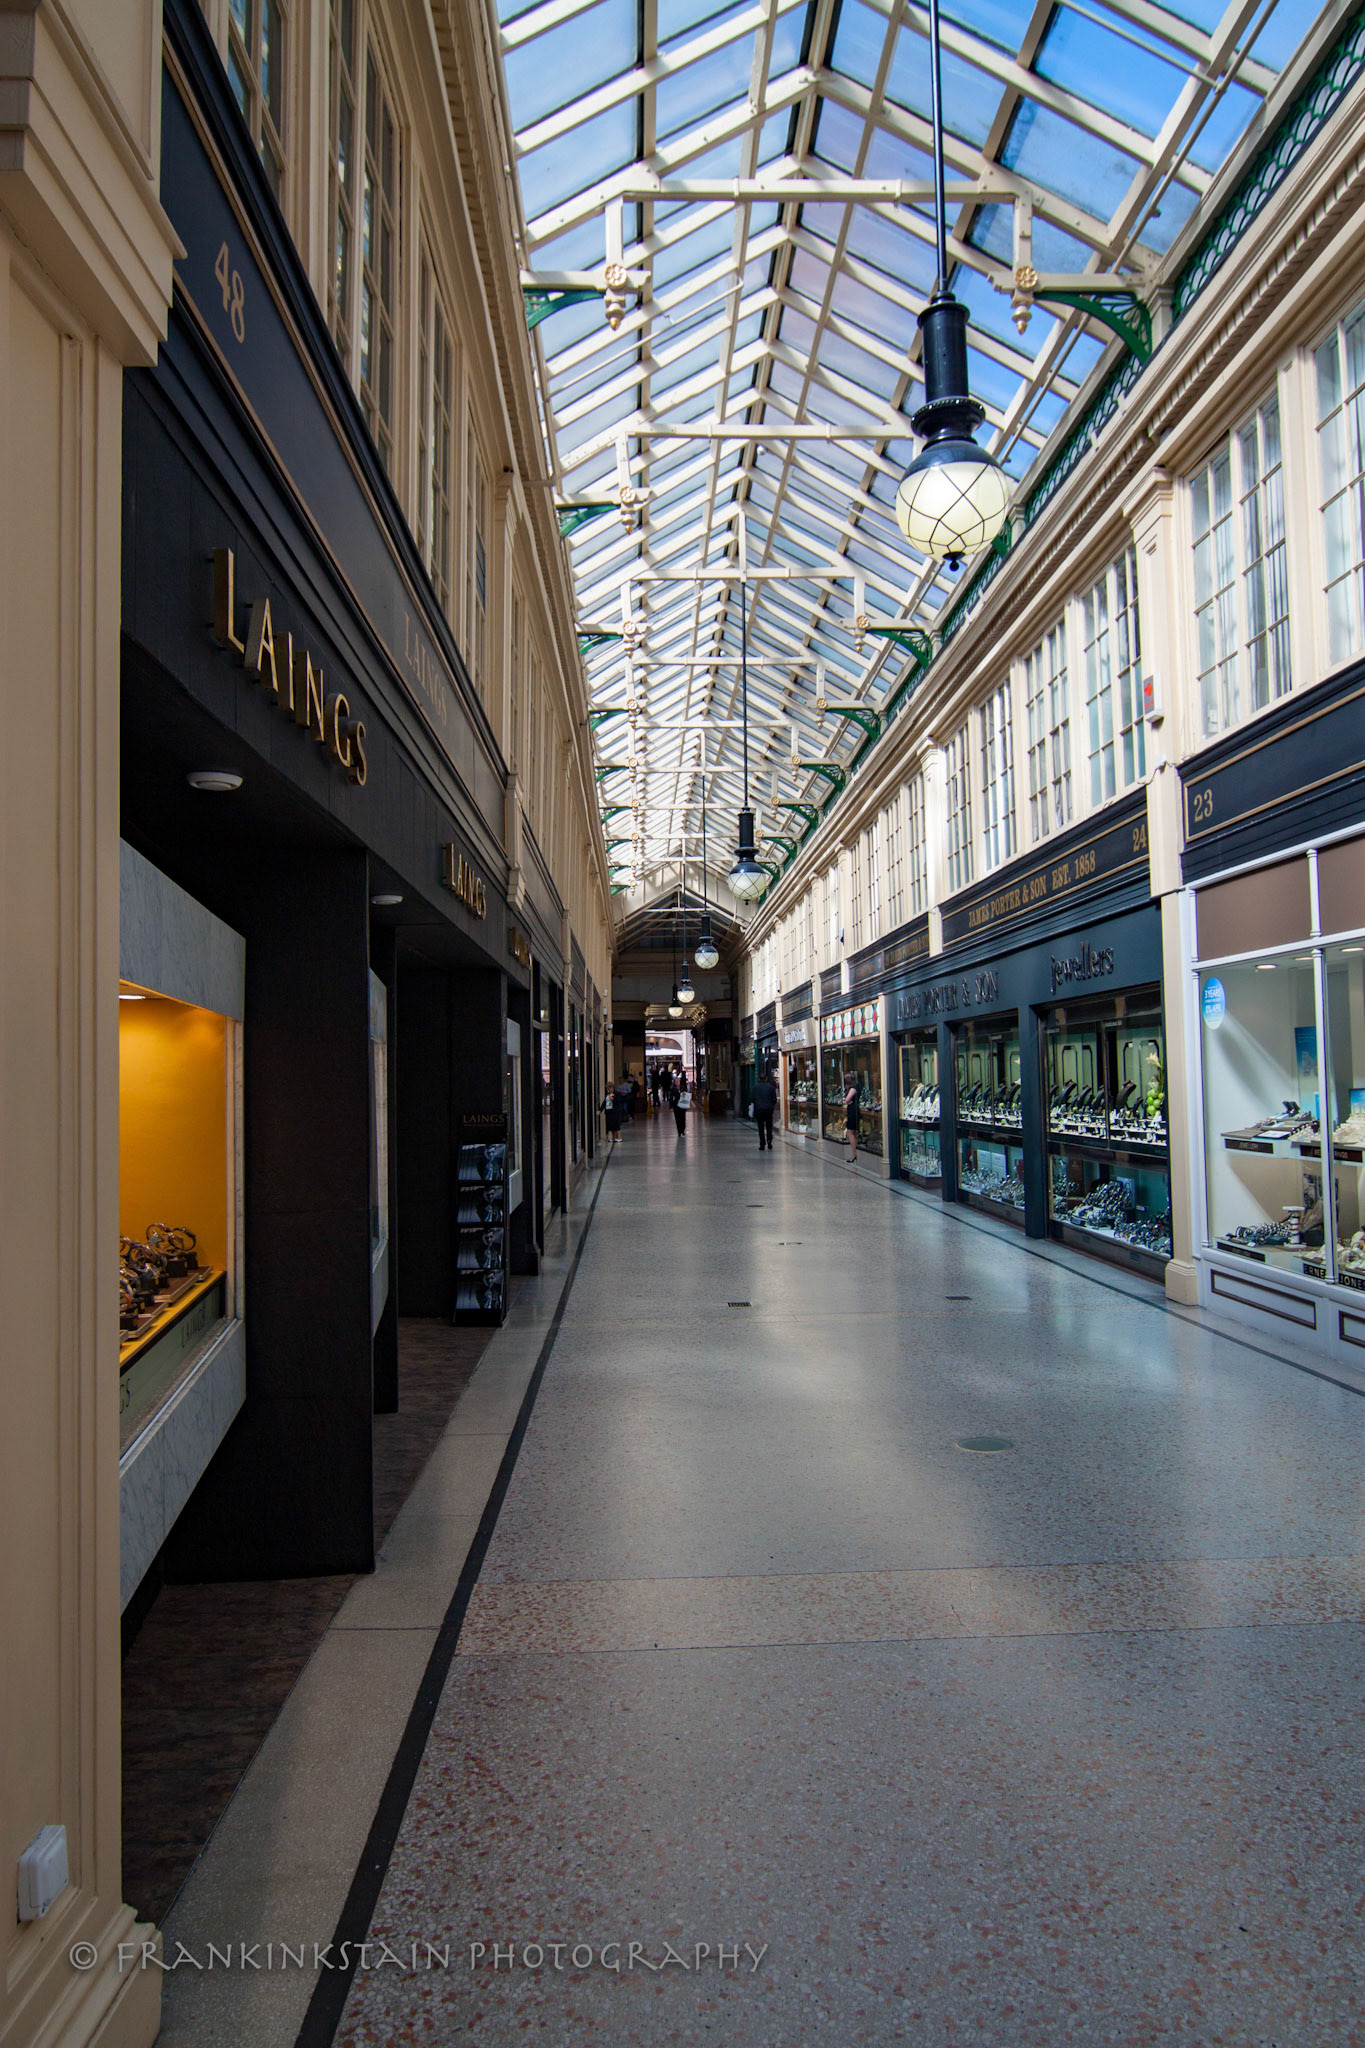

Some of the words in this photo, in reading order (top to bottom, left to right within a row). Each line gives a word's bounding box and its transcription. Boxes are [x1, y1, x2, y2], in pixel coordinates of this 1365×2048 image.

[215, 241, 245, 344] 48
[214, 547, 367, 787] LAINGS
[405, 611, 447, 728] LAINGS
[1132, 824, 1147, 852] 24
[1193, 788, 1214, 823] 23
[446, 843, 487, 921] LAINGS
[968, 903, 990, 929] JAMES
[991, 888, 1021, 919] PORTER
[1022, 884, 1029, 904] &
[1029, 875, 1047, 900] SON
[1051, 863, 1072, 891] EST.
[1074, 850, 1096, 880] 1858
[962, 977, 971, 1008] &
[975, 968, 999, 1005] SON
[1050, 940, 1115, 996] jewellers
[463, 1113, 505, 1123] LAINGS
